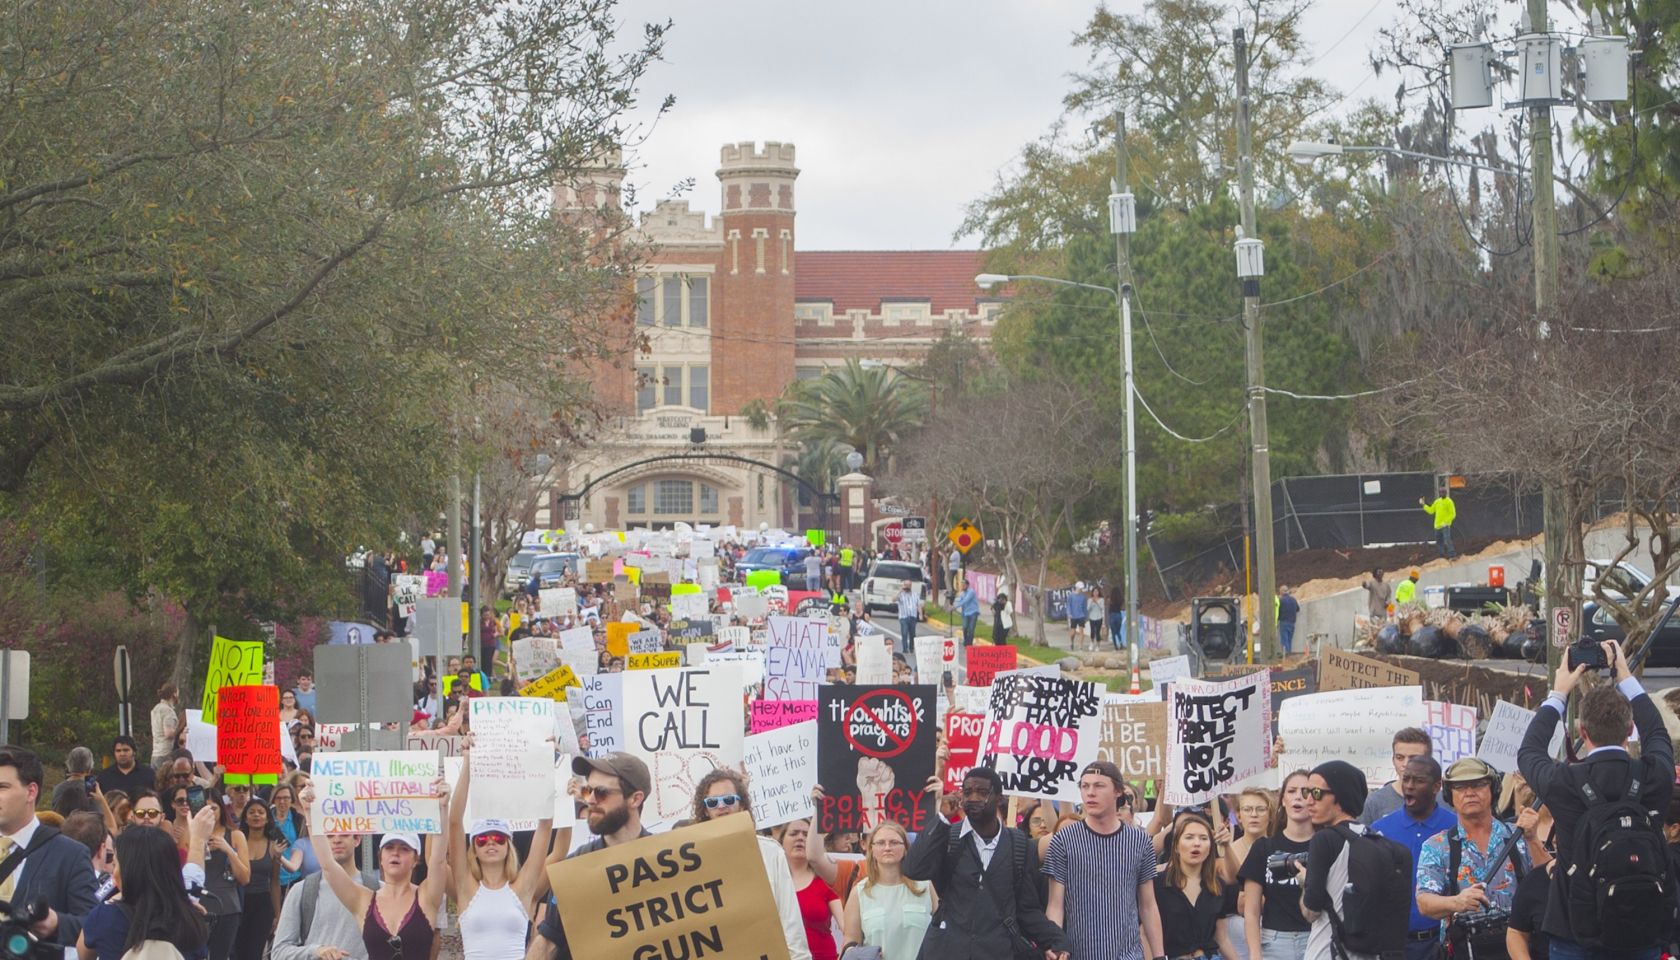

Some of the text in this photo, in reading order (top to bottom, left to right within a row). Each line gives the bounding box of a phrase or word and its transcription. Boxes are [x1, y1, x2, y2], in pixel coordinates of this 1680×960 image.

[769, 618, 828, 649] WHAT
[213, 642, 262, 671] NOT
[628, 653, 681, 668] BE A SUPER
[768, 646, 827, 679] EMMA
[968, 672, 994, 688] ARE
[1328, 653, 1410, 687] PROTECT THE
[582, 676, 603, 691] We
[651, 670, 711, 708] WE
[1271, 679, 1306, 693] ENCE
[584, 695, 613, 711] Can
[753, 701, 780, 716] Hey
[829, 698, 908, 722] thoughts
[1175, 684, 1257, 719] PROTECT
[224, 720, 273, 735] children
[586, 712, 613, 730] End
[1025, 707, 1080, 730] HAVE
[1423, 702, 1477, 731] HILD
[320, 724, 350, 735] FEAR
[588, 732, 615, 748] Gun
[638, 710, 721, 752] CALL
[850, 722, 910, 751] prayers
[1121, 722, 1147, 744] BE
[1177, 712, 1237, 745] PEOPLE
[220, 734, 276, 751] more than
[744, 735, 810, 765] on't have to
[985, 720, 1078, 762] BLOOD
[220, 751, 249, 768] your
[1183, 737, 1235, 770] NOT
[313, 759, 382, 777] MENTAL
[760, 763, 780, 778] like
[784, 756, 806, 771] this
[948, 766, 974, 783] NO
[1013, 754, 1079, 783] YOUR
[1184, 756, 1235, 794] GUNS
[355, 779, 438, 798] INEVITABLE
[762, 783, 788, 801] have
[792, 778, 803, 791] to
[998, 771, 1060, 795] ANDS
[321, 798, 413, 816] GUN LAWS
[776, 799, 800, 817] like
[823, 788, 925, 814] POLICY
[323, 816, 352, 833] CAN
[355, 817, 376, 832] BE
[821, 809, 927, 832] CHANGE
[605, 842, 703, 895] PASS
[605, 878, 725, 939] STRICT
[632, 925, 725, 960] GUN
